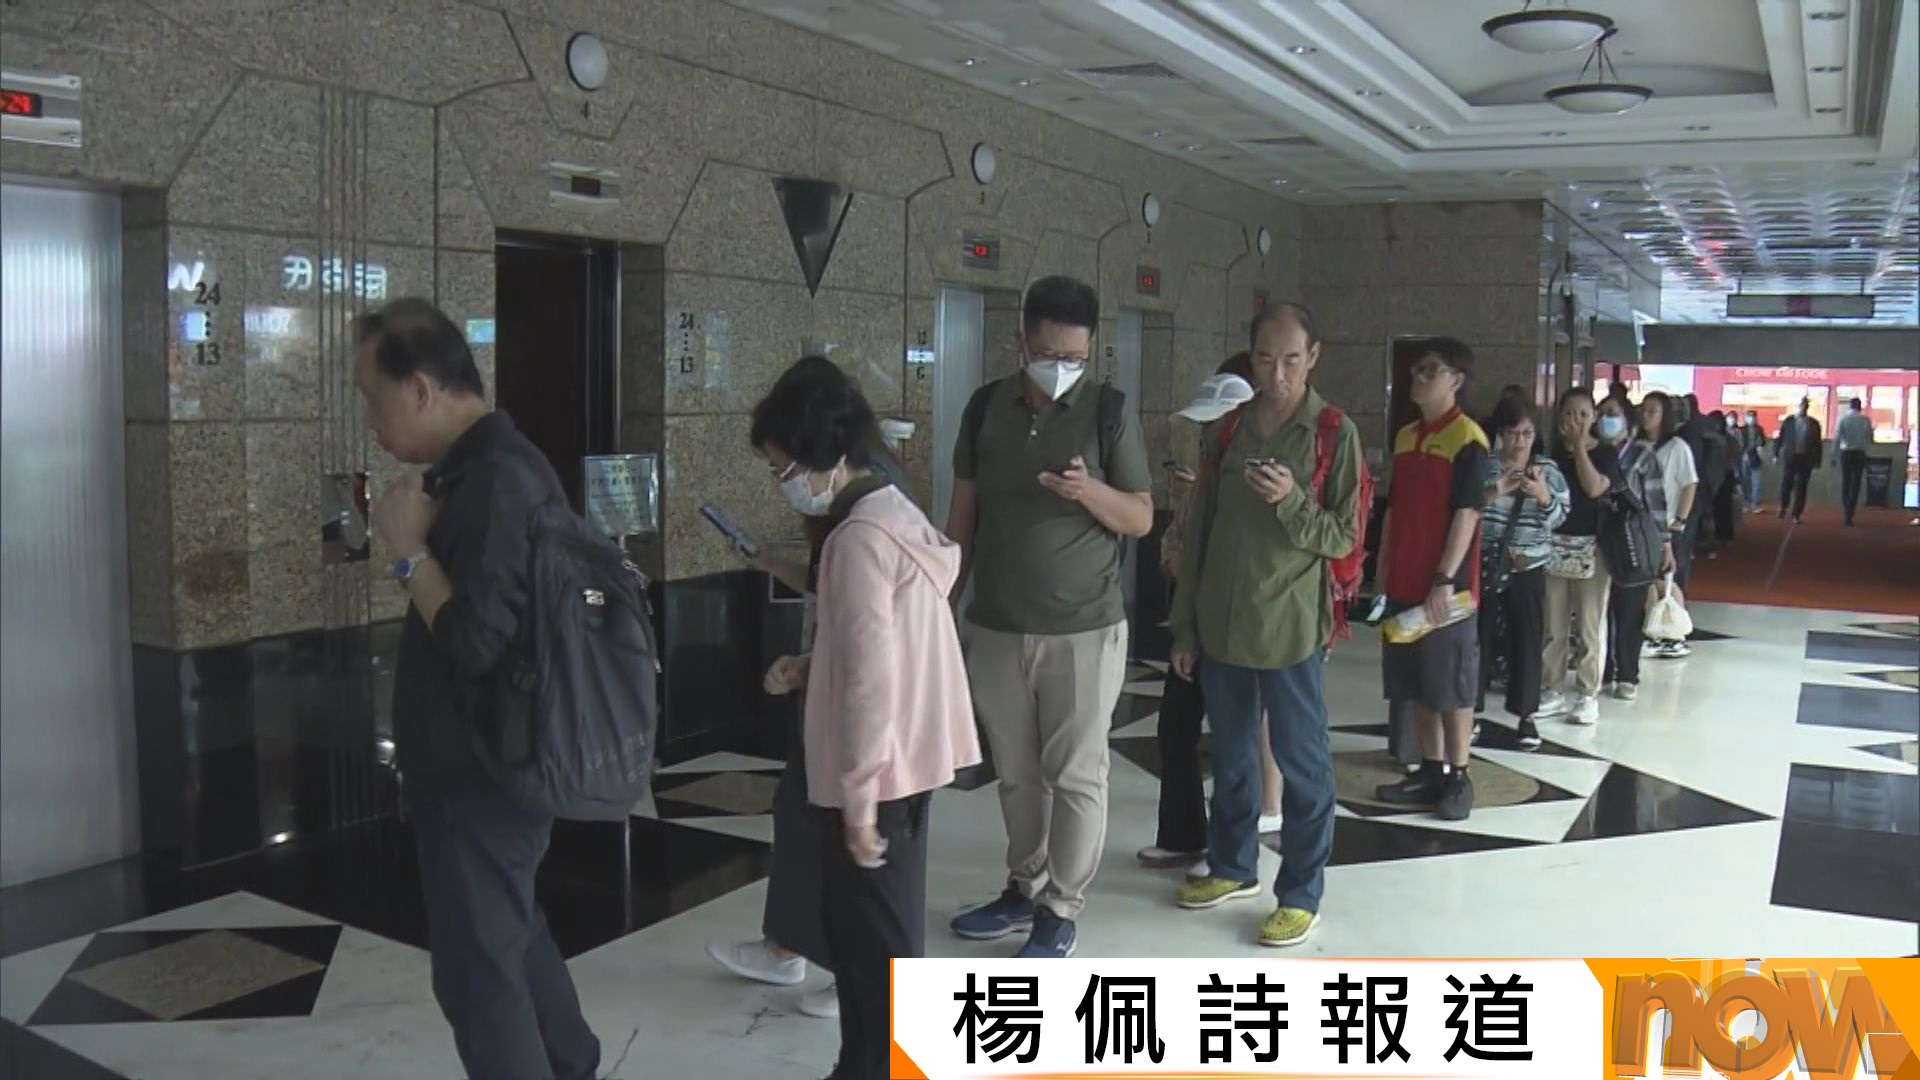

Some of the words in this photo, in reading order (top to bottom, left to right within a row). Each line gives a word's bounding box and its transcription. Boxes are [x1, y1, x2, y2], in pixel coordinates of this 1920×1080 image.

[195, 282, 221, 305] 24
[197, 342, 221, 366] 13
[681, 356, 694, 374] 13
